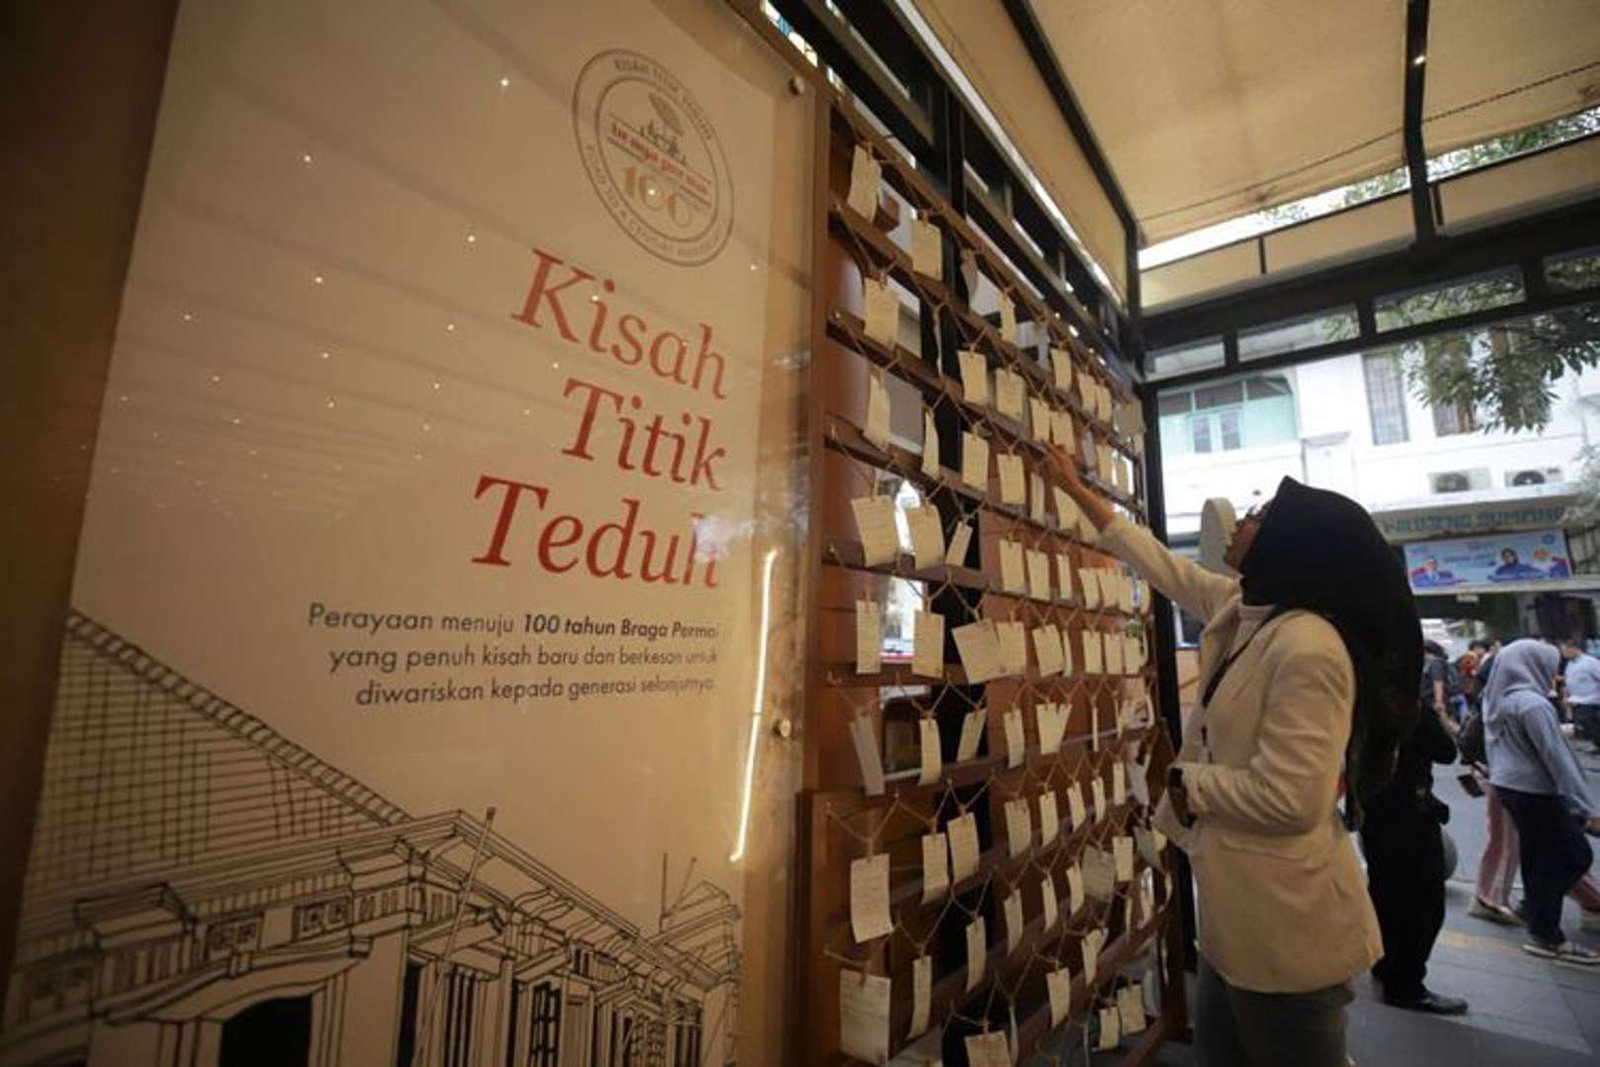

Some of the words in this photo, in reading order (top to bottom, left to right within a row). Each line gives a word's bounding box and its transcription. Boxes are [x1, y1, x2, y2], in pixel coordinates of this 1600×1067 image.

[511, 248, 727, 400] Kisah
[562, 378, 727, 492] Titik
[471, 475, 719, 588] Teduh
[308, 602, 433, 635] Perayaan
[442, 615, 513, 637] menuju
[525, 613, 560, 634] 100
[565, 615, 615, 636] tahun
[620, 618, 667, 641] Braga
[328, 650, 398, 674] yang
[406, 644, 475, 673] penuh
[482, 643, 531, 666] kisah
[537, 644, 577, 666] baru
[584, 645, 615, 665] dan
[620, 645, 682, 665] berkesan
[356, 678, 483, 705] diwariskan
[491, 676, 563, 703] kepada
[569, 678, 638, 701] generasi
